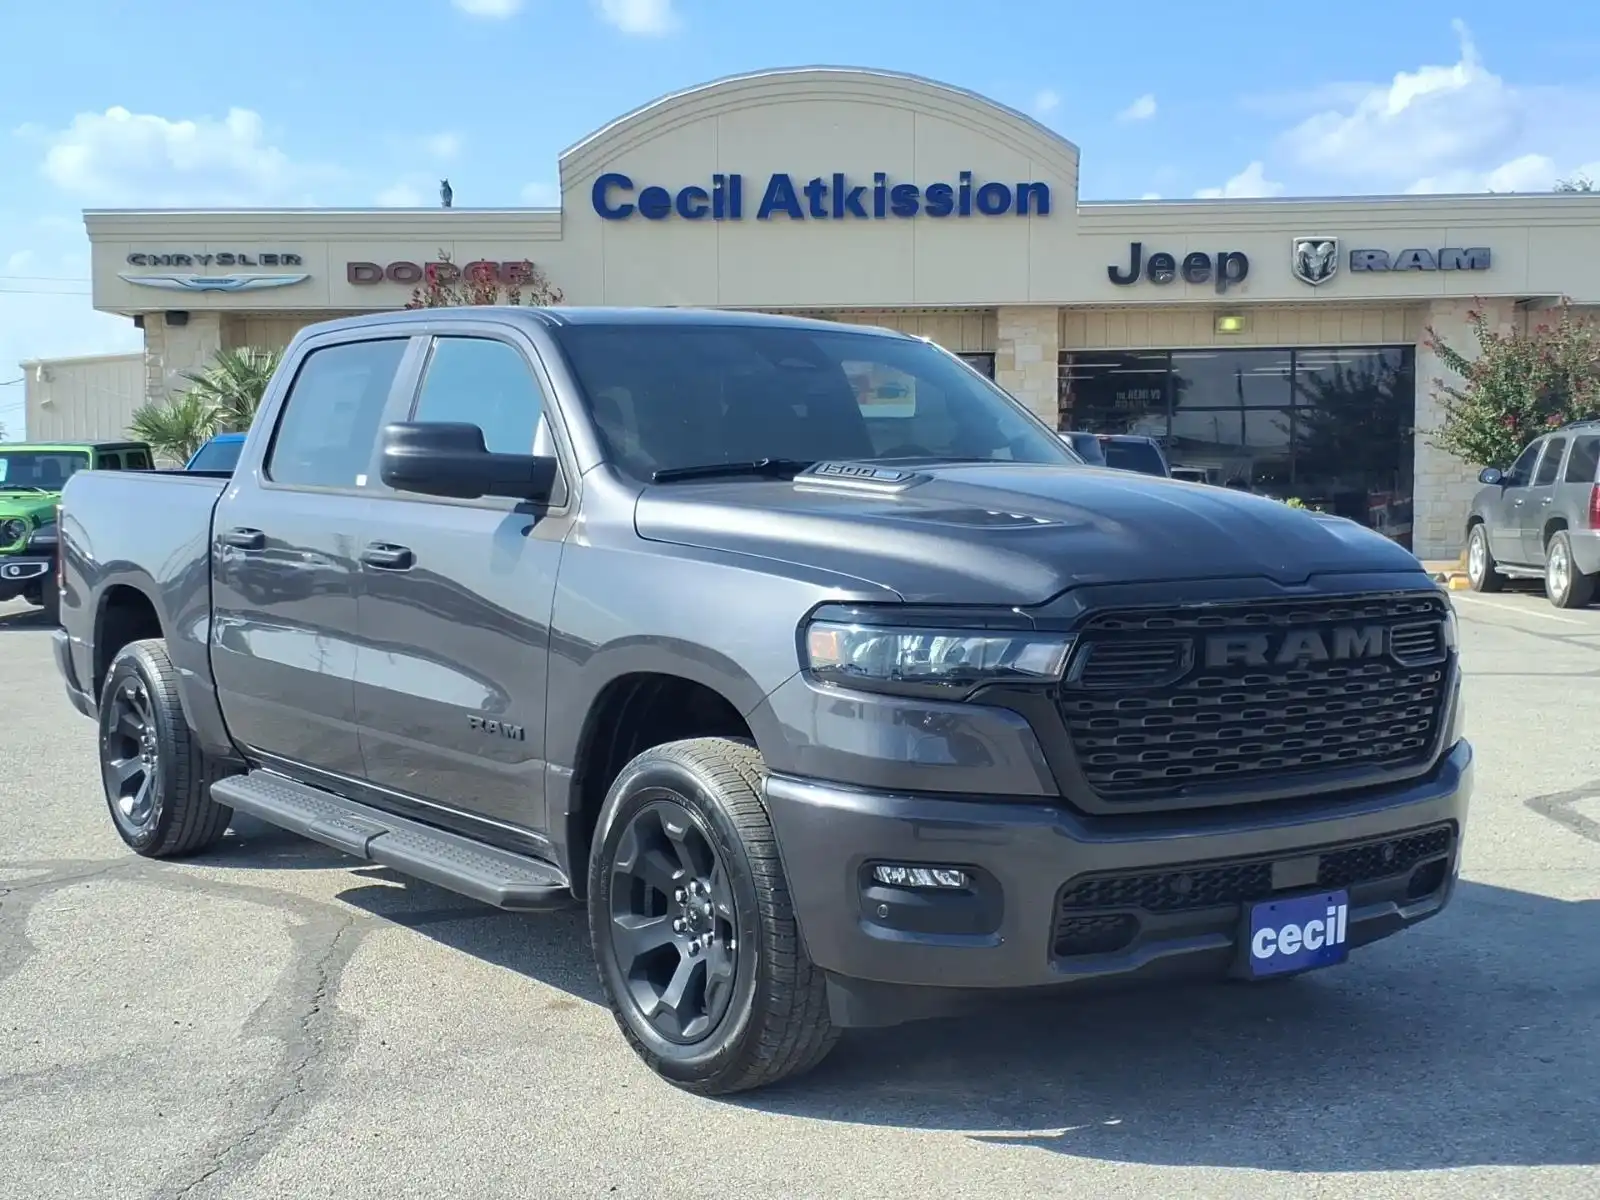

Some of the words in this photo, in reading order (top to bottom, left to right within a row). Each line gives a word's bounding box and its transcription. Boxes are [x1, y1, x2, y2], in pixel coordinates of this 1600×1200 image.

[591, 172, 742, 221] Cecil
[756, 170, 1051, 221] Atkission
[127, 252, 304, 266] CHRYSLER
[1107, 242, 1249, 295] Jeep
[1350, 247, 1491, 273] RAM
[1205, 625, 1384, 669] RAM
[466, 714, 525, 741] RAM
[1252, 904, 1347, 959] cecil
